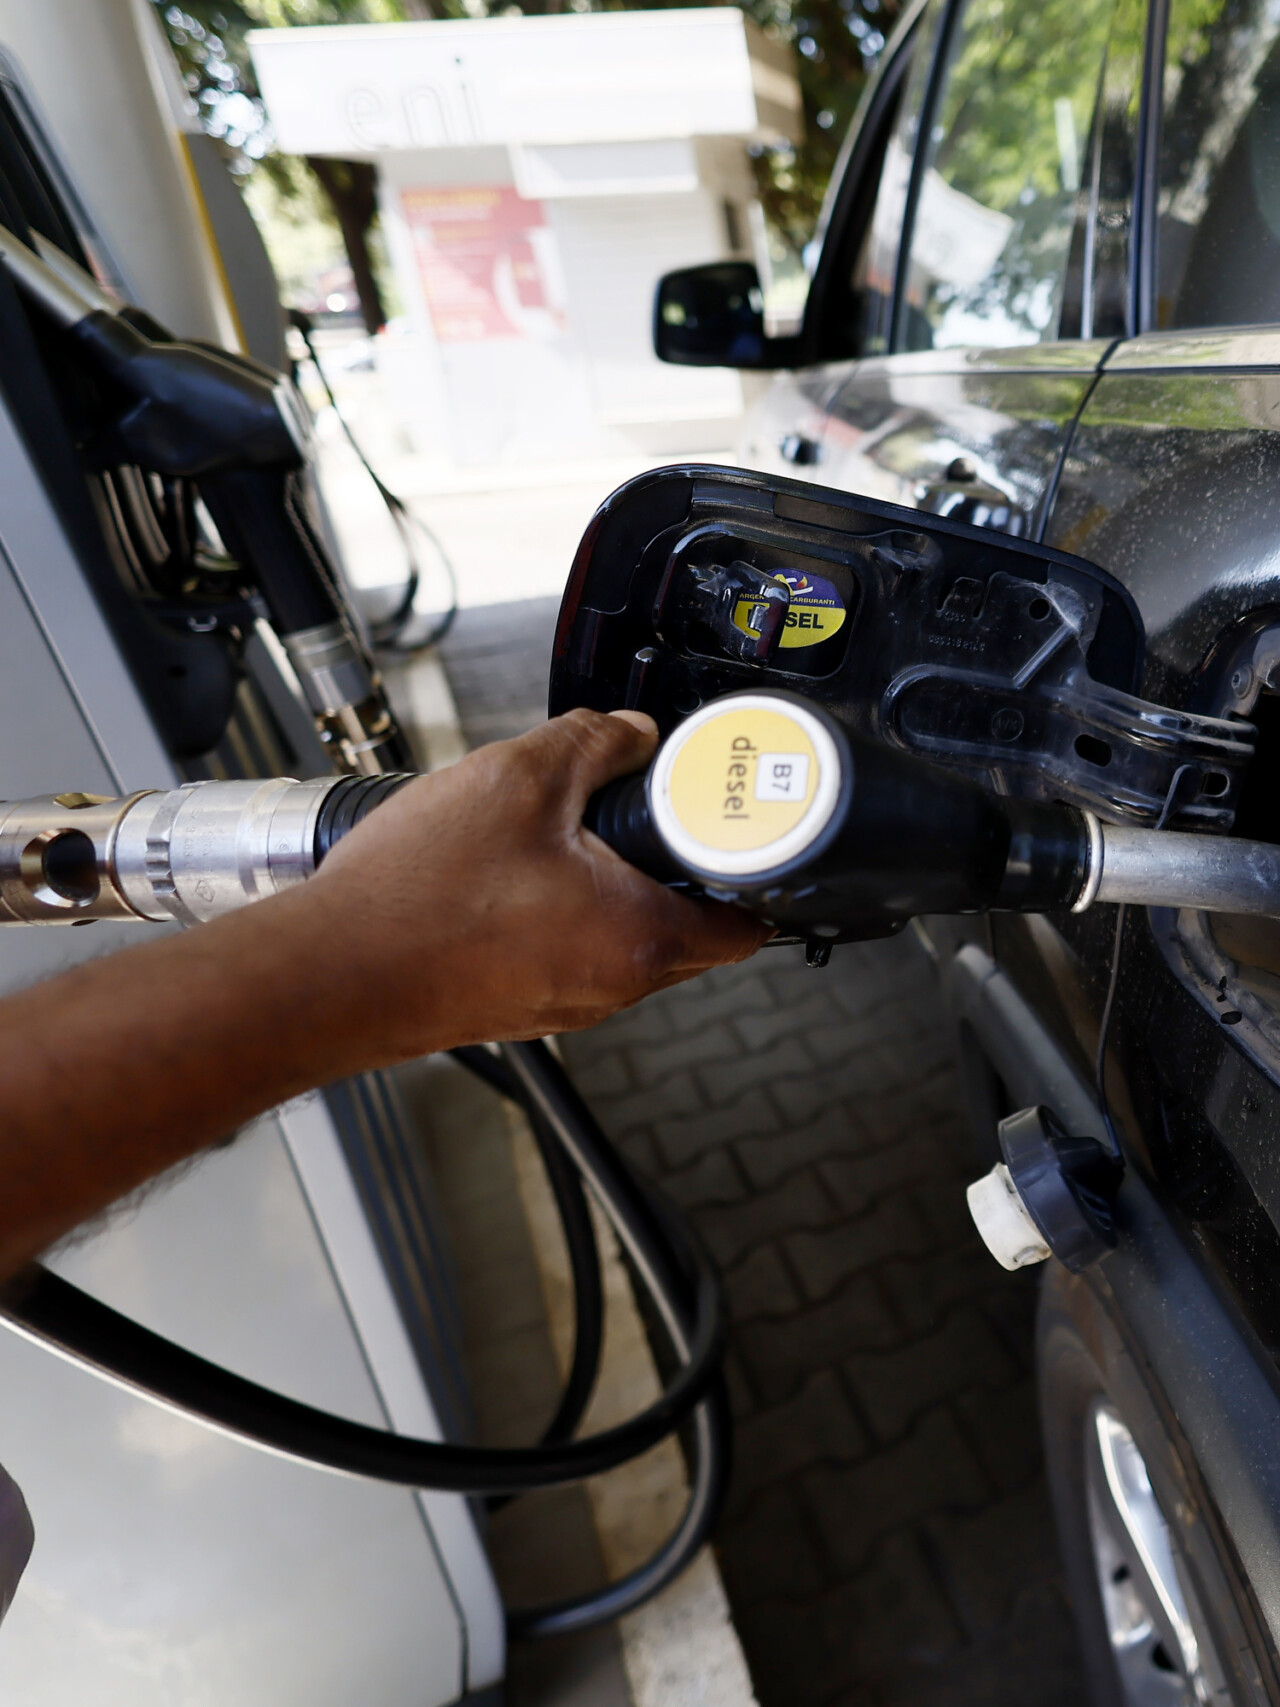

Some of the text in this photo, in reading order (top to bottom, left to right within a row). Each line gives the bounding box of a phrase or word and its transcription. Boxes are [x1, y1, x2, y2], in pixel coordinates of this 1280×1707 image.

[345, 57, 484, 150] eni
[723, 736, 758, 820] diesel
[772, 764, 793, 792] B7
